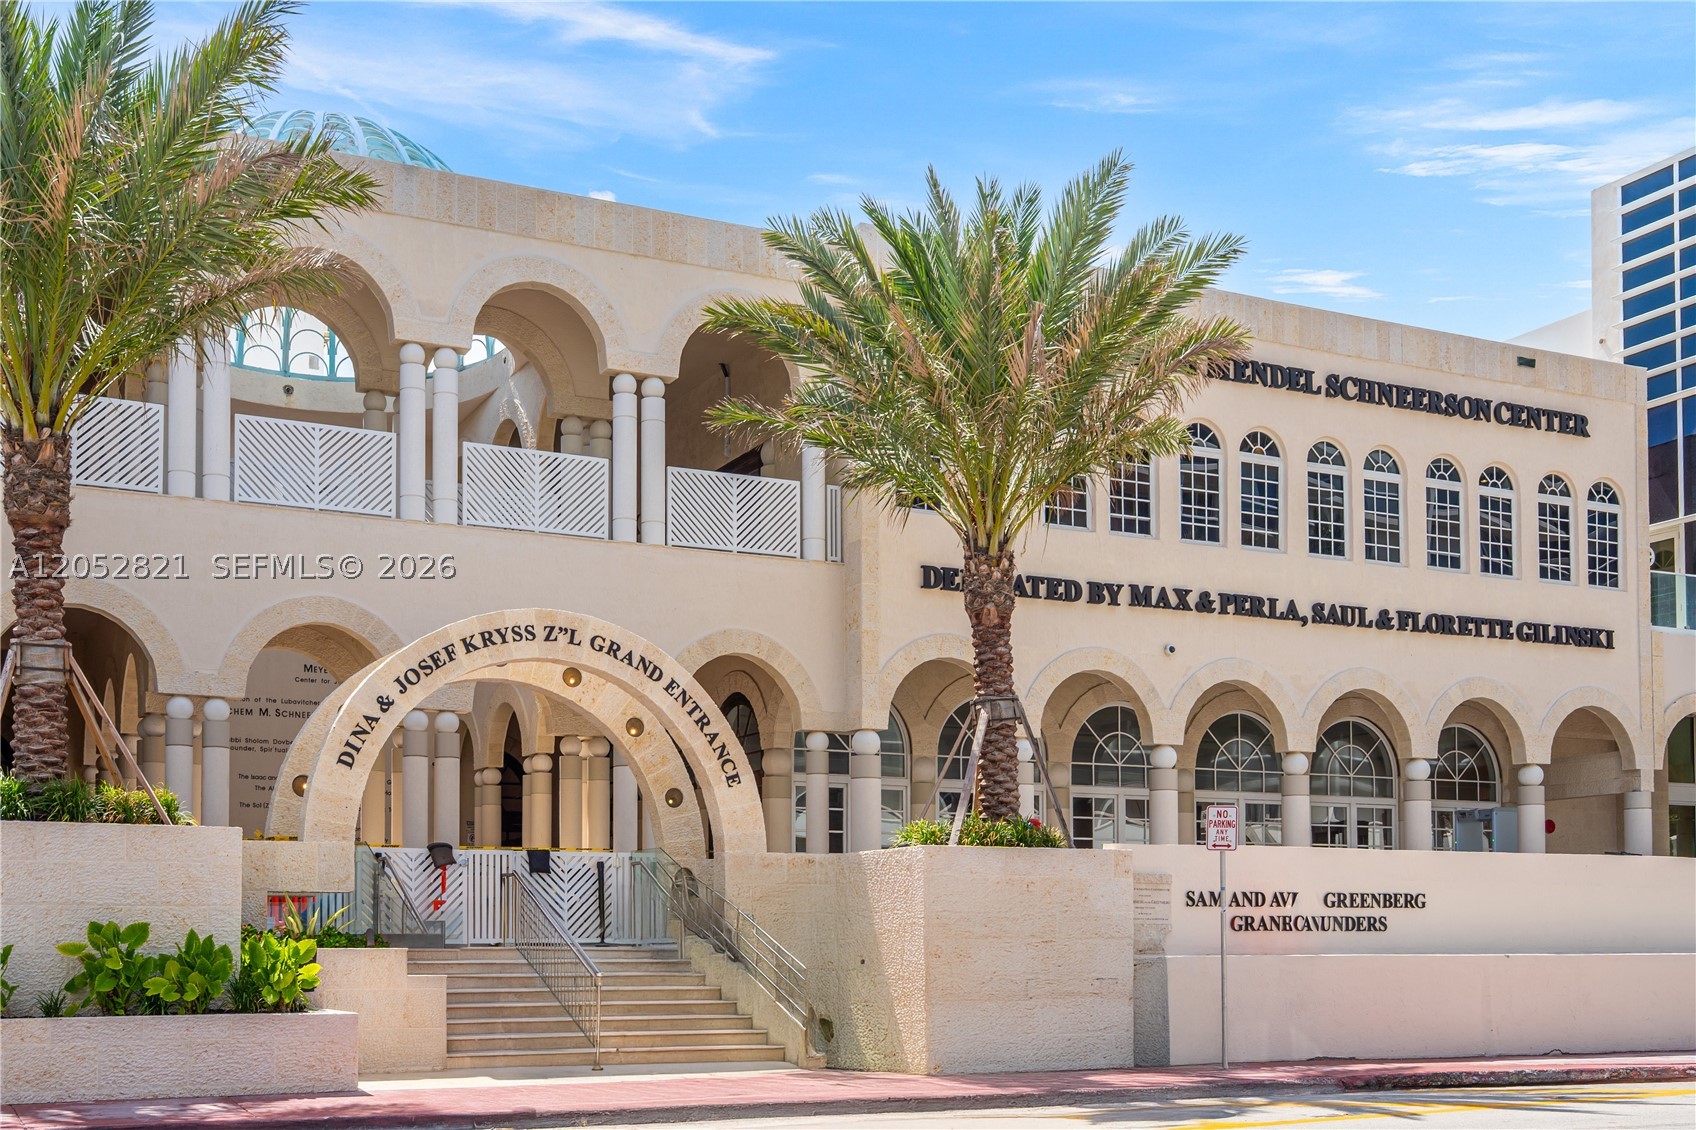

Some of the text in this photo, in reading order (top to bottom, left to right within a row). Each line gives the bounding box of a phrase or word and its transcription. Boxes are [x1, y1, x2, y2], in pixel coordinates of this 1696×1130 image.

[1325, 374, 1493, 422] SCHNEERSON
[1494, 401, 1591, 438] CENTER
[920, 565, 1615, 649] DEATED BY MAX & PERLA, SAUL & FLORETTE GILINSKI
[259, 707, 271, 717] M.
[336, 712, 381, 770] DINA
[376, 695, 395, 713] &
[393, 643, 457, 694] JOSEF
[459, 625, 536, 654] KRYSS
[589, 635, 664, 682] GRAND
[662, 677, 742, 788] ENTRANCE
[1216, 810, 1228, 818] NO
[1208, 820, 1235, 828] PARKING
[1186, 890, 1221, 907] SAM
[1229, 891, 1266, 907] AND
[1323, 892, 1427, 909] GREENBERG
